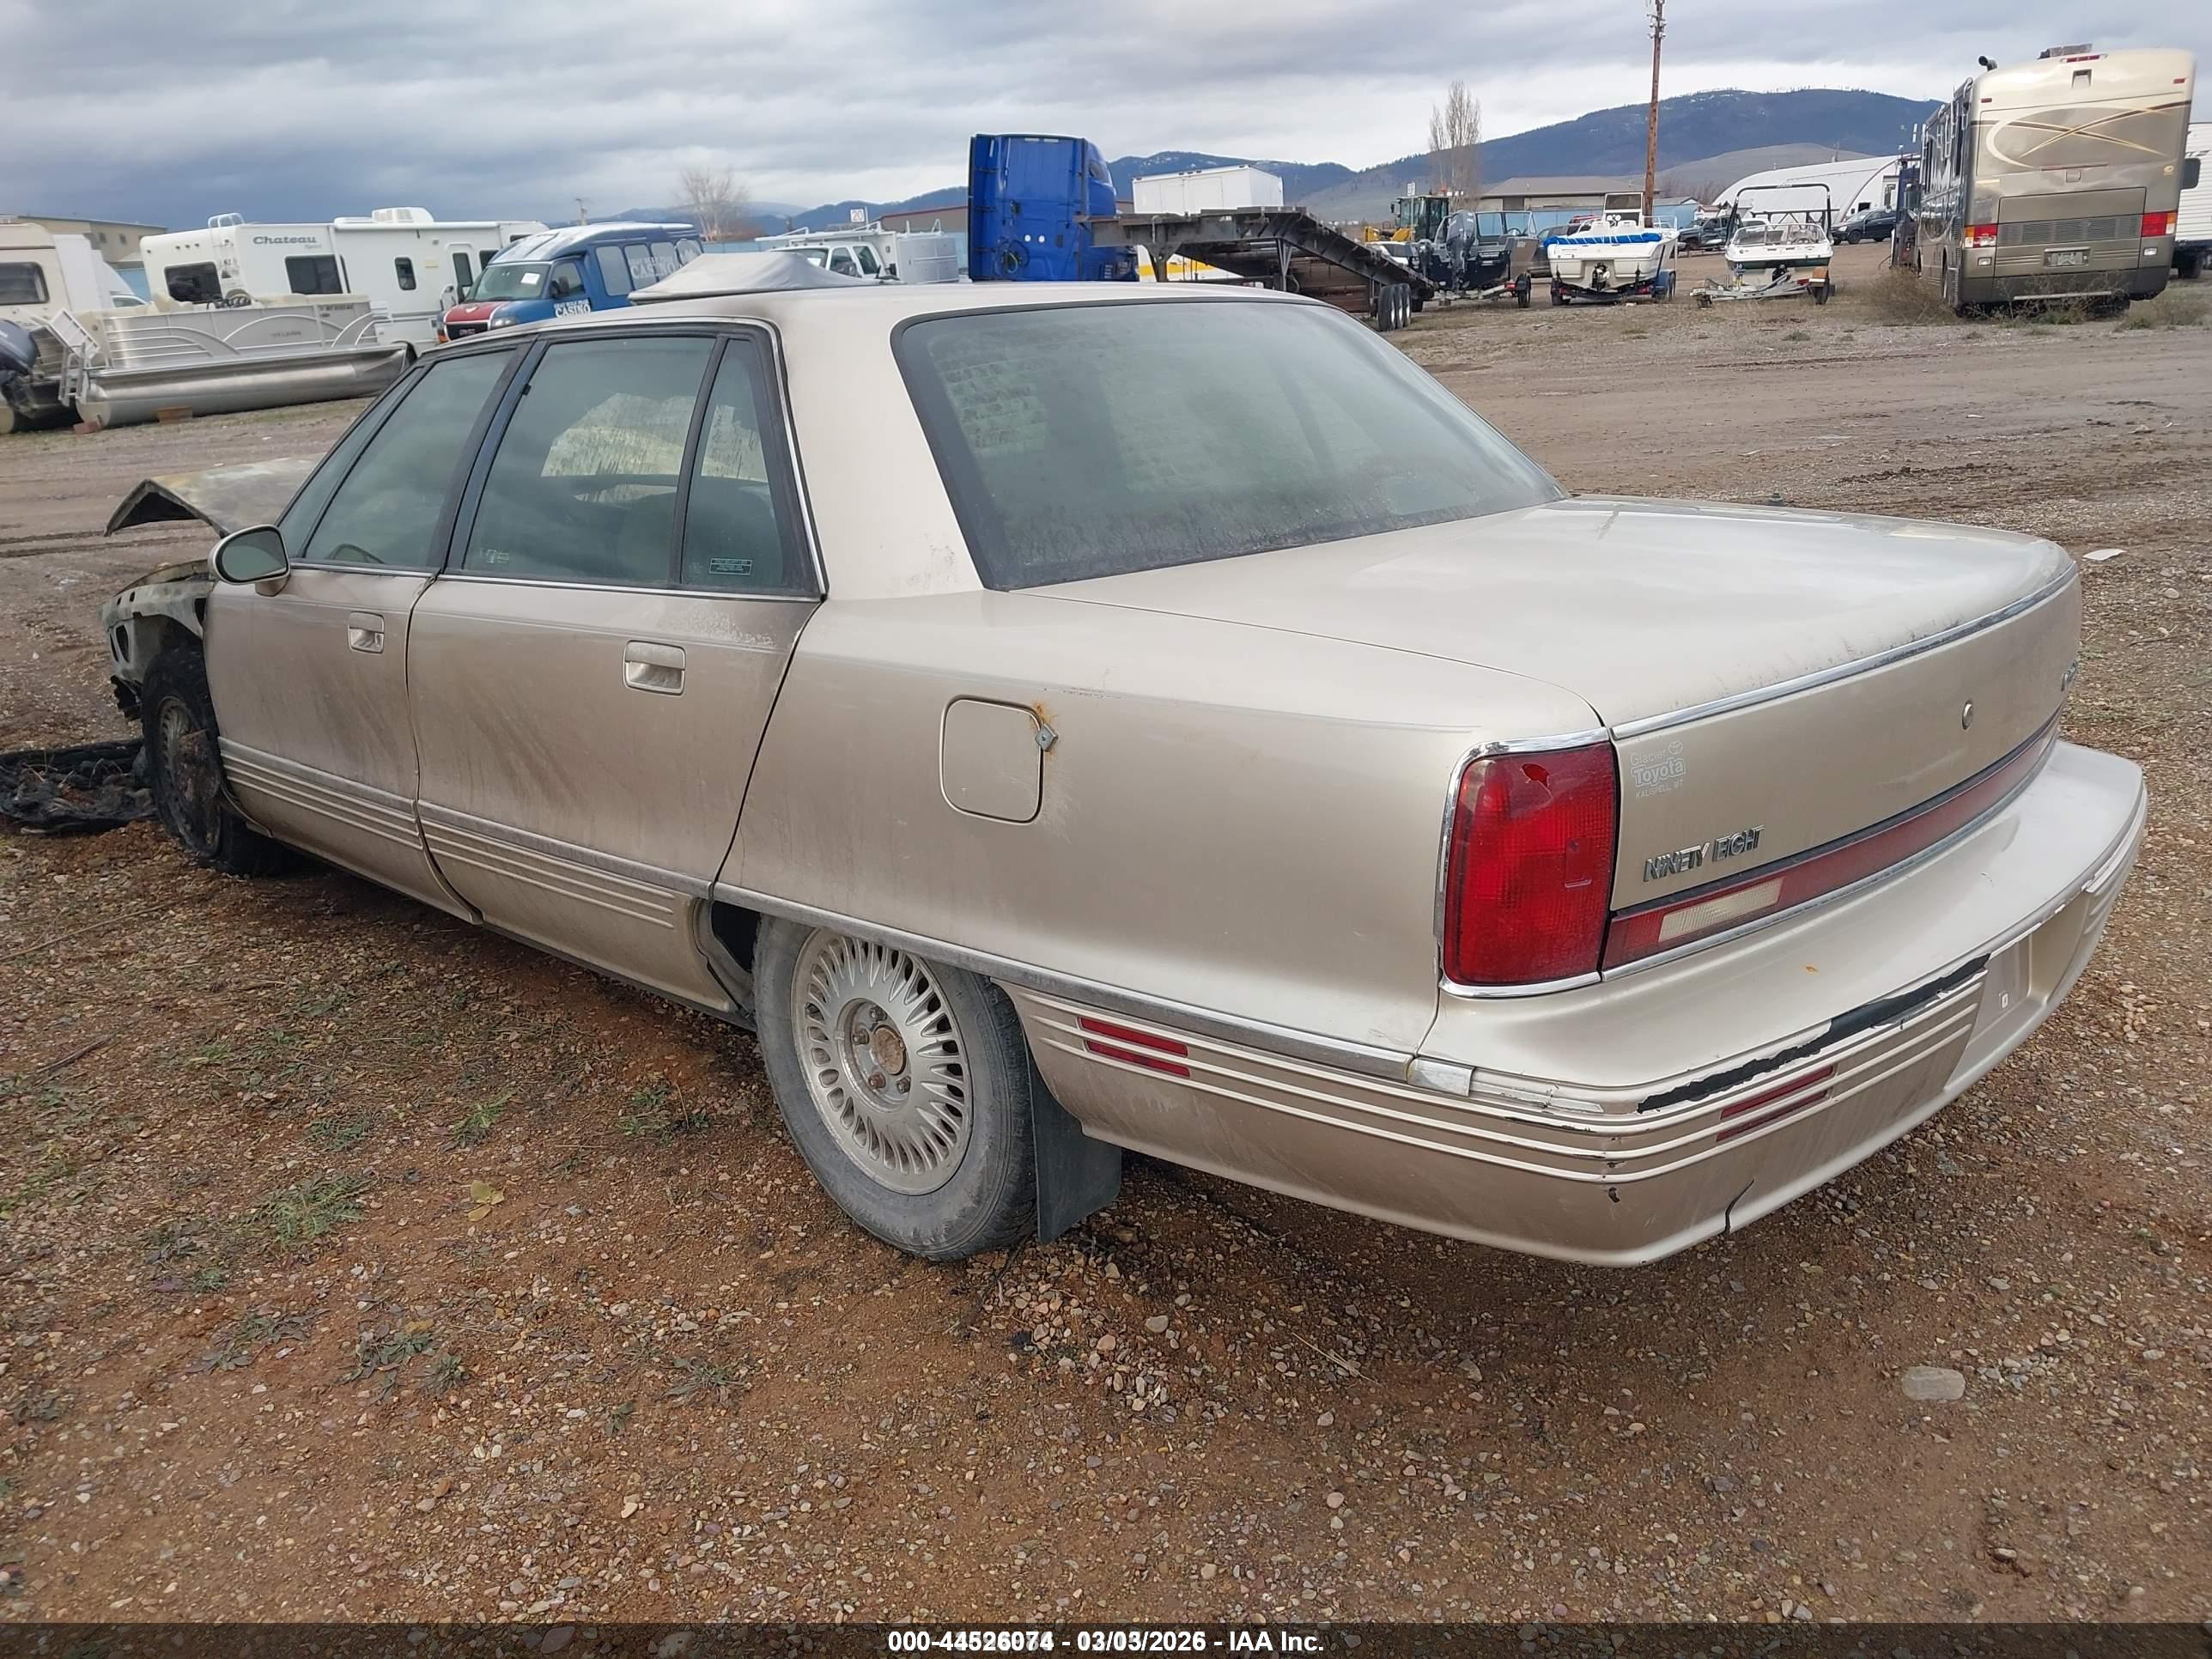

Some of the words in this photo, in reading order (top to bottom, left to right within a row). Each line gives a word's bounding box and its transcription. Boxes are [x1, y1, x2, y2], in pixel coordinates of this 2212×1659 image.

[252, 236, 317, 245] Chateau
[555, 303, 592, 318] CASINO
[1632, 757, 1686, 787] Toyota
[1644, 842, 1711, 882] NINETY
[1712, 824, 1765, 862] EIGHT
